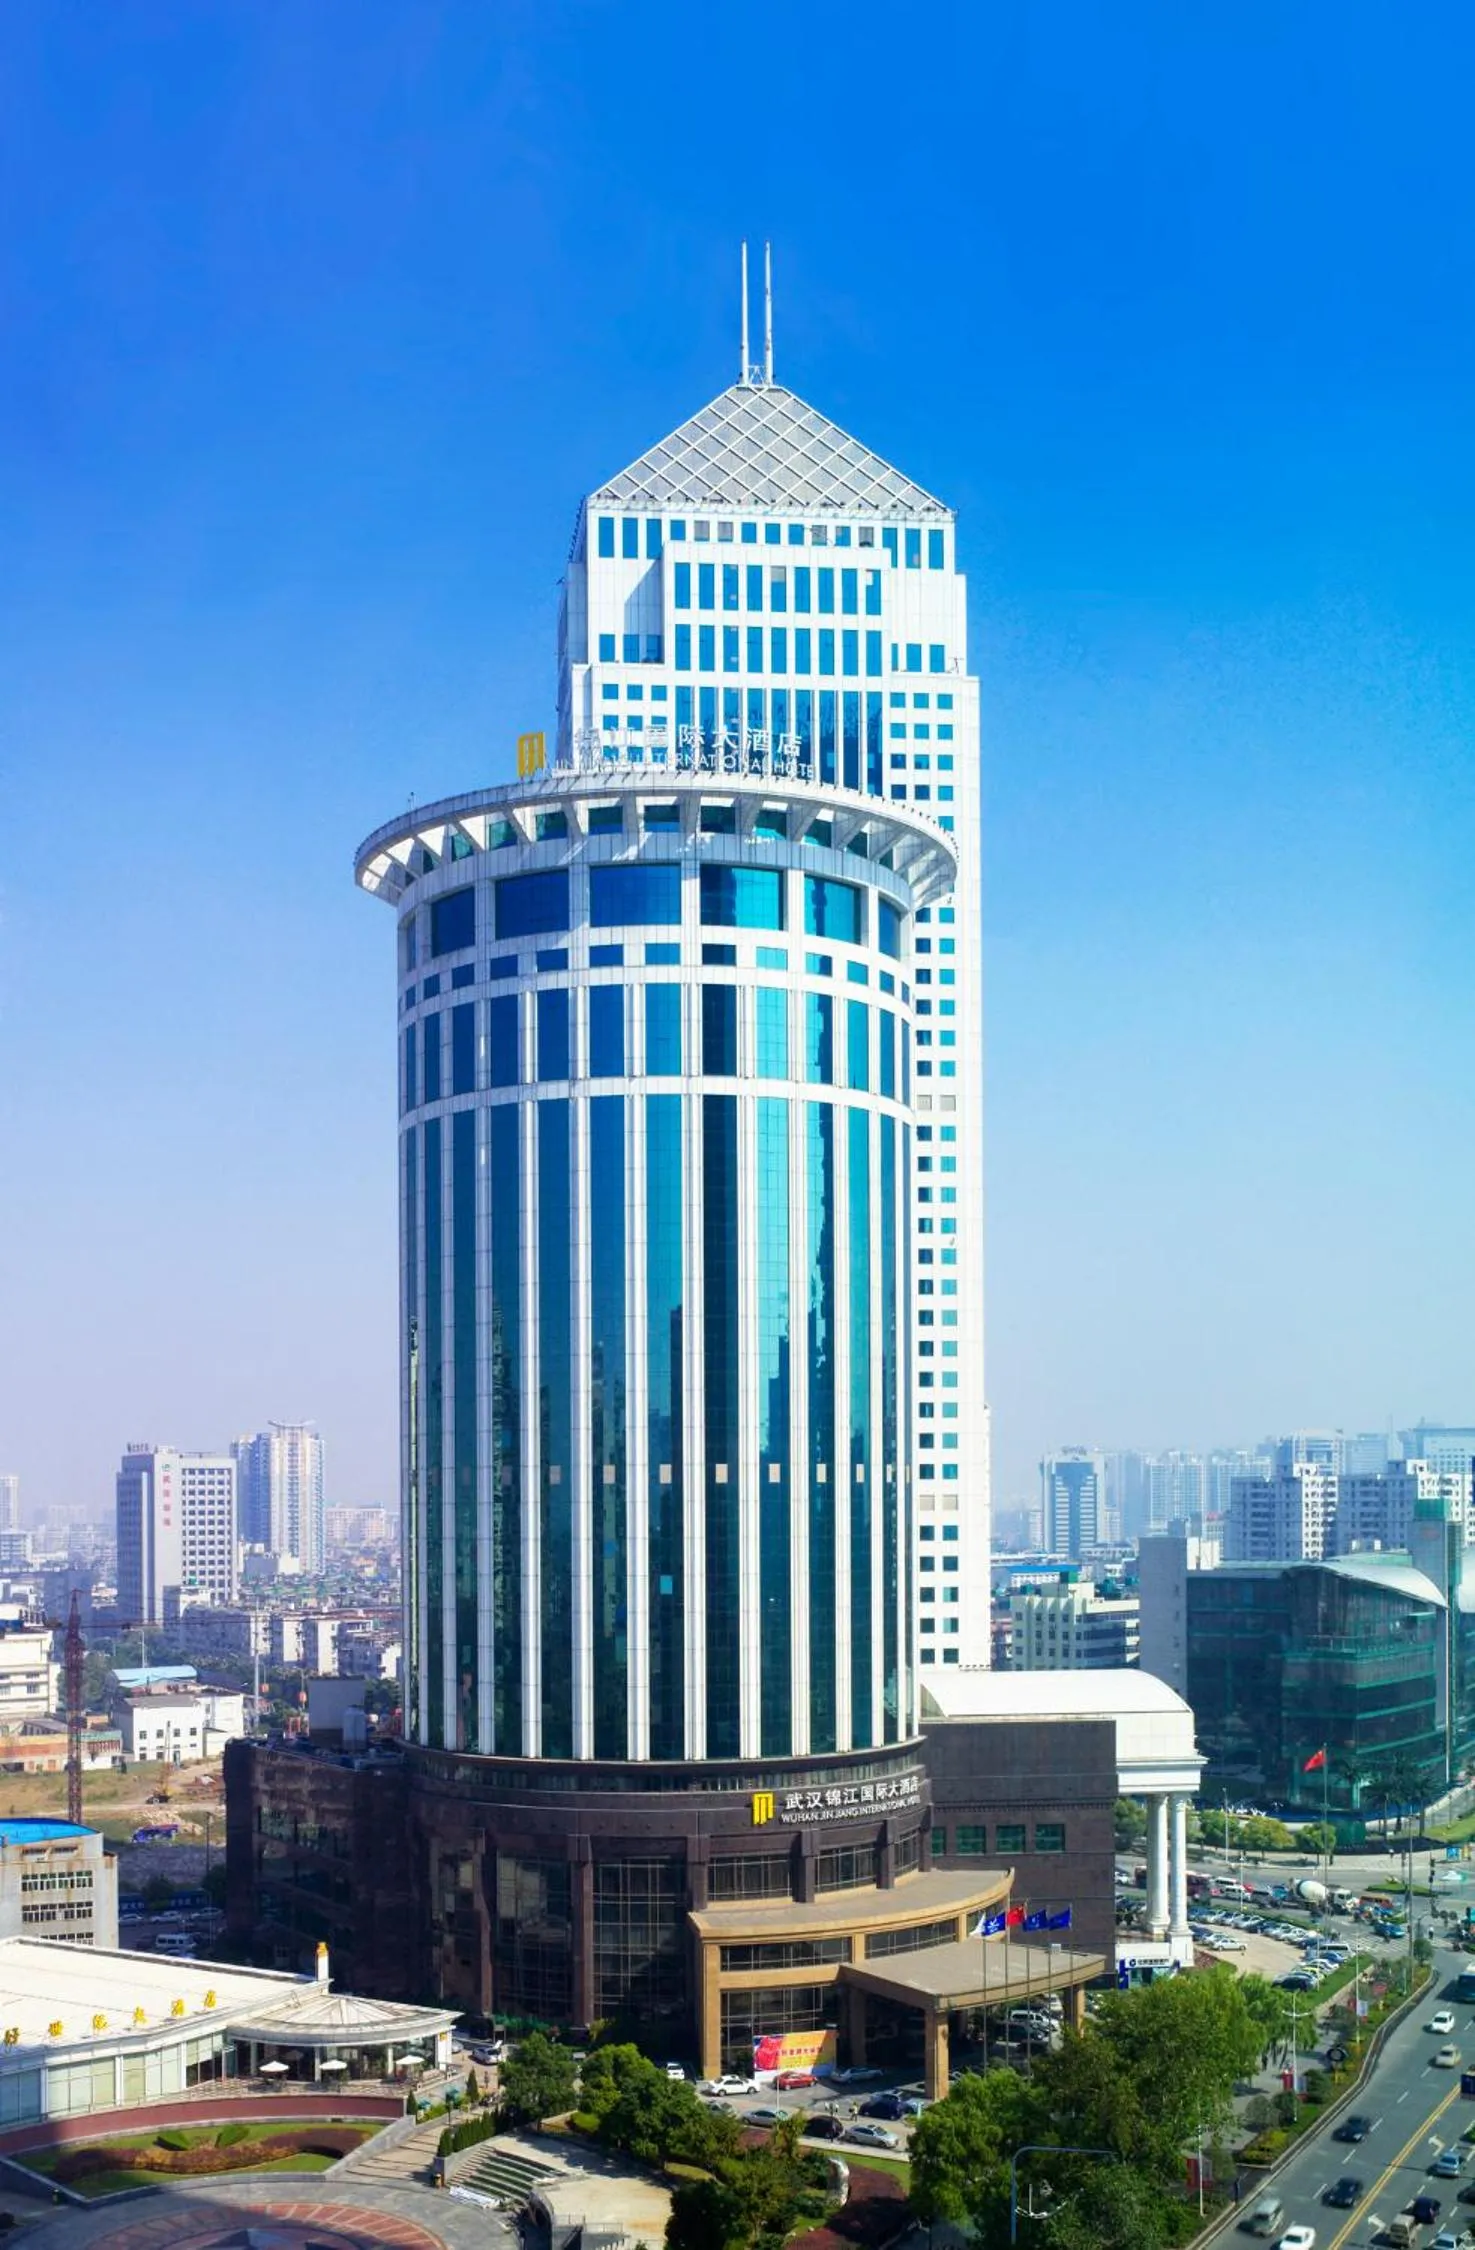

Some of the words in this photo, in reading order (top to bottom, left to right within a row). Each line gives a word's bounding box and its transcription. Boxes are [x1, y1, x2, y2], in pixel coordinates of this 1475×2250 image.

[785, 1776, 920, 1809] 武汉锦江国际大酒店
[781, 1811, 818, 1824] WUHAN
